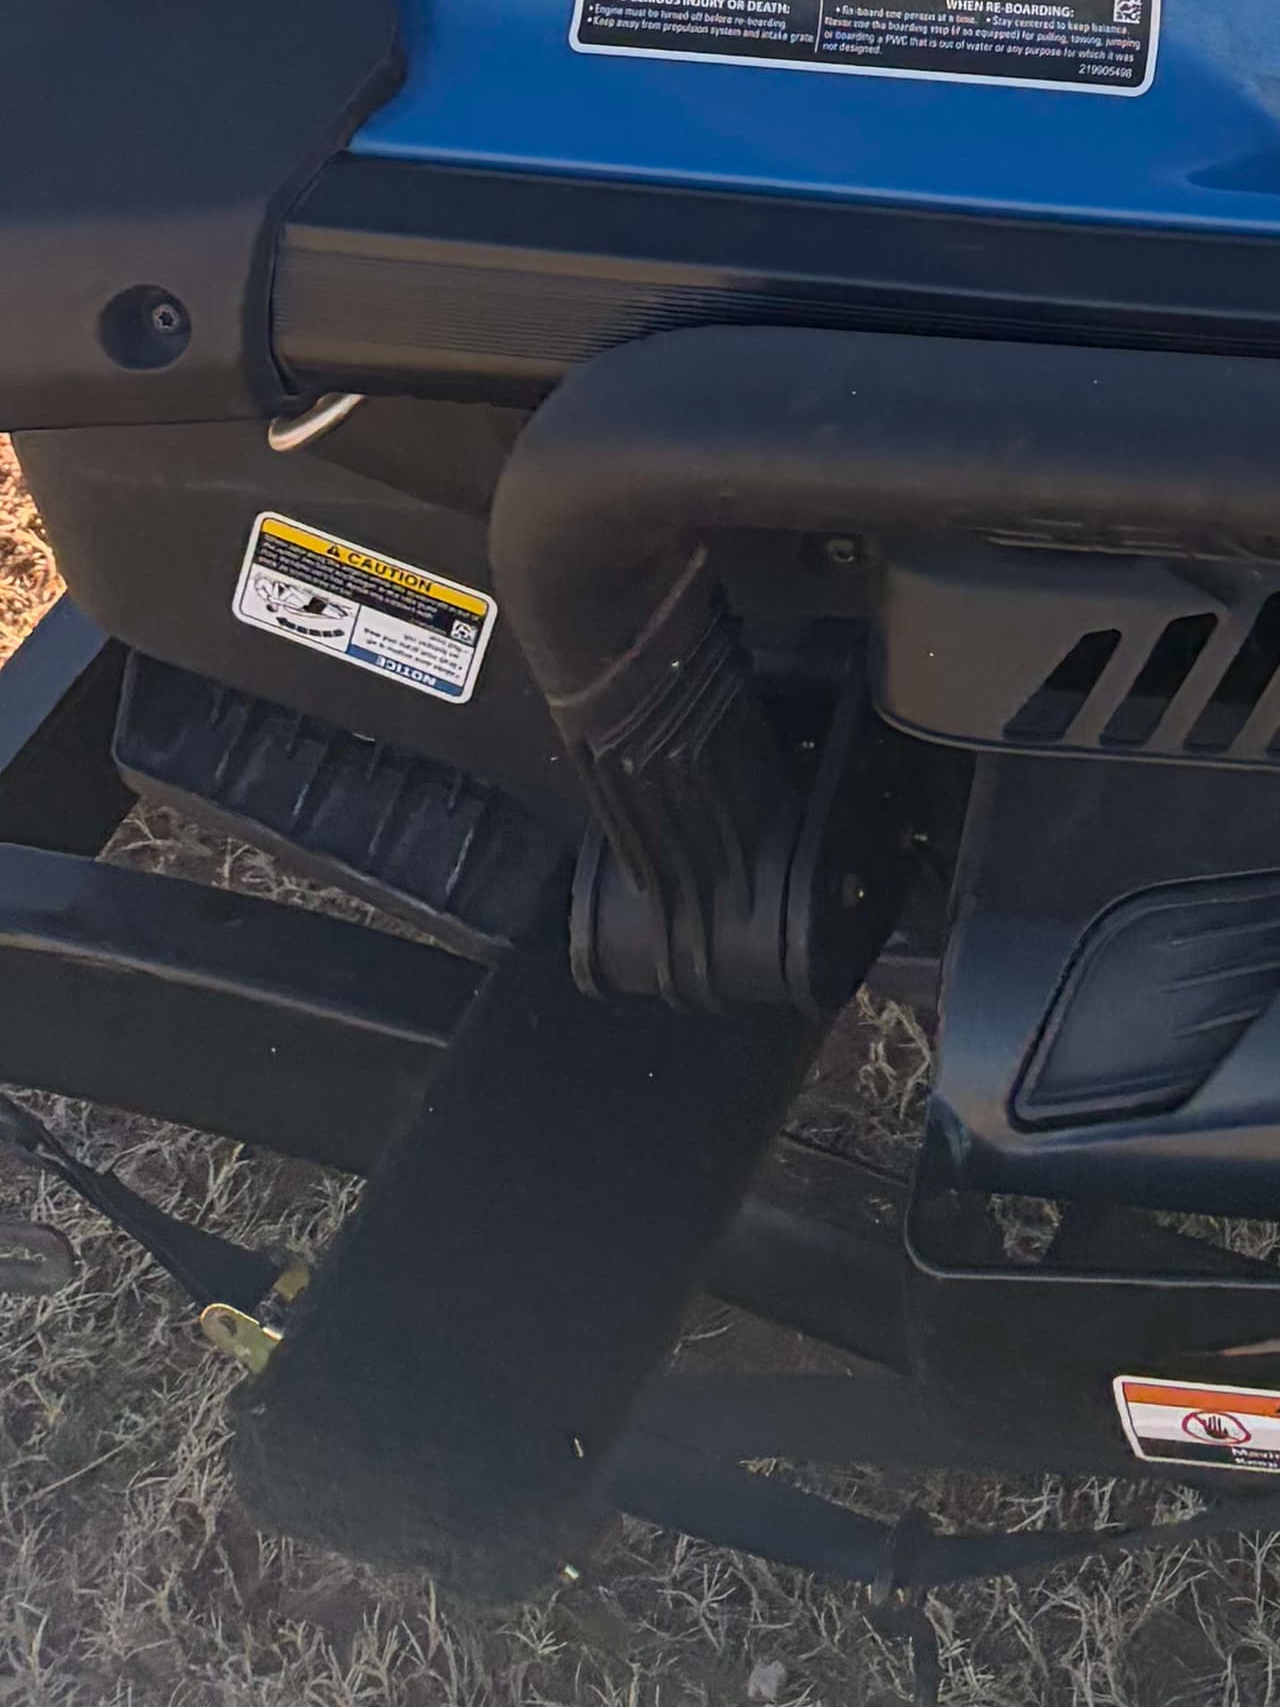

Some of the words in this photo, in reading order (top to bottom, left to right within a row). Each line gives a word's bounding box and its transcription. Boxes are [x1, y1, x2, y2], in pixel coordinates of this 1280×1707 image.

[594, 3, 623, 17] Engine
[625, 6, 646, 18] must
[647, 8, 659, 19] be
[660, 9, 689, 21] turned
[691, 11, 702, 22] off
[703, 12, 732, 25] before
[746, 0, 791, 14] DEATH:
[985, 1, 1075, 18] RE-BOARDING:
[593, 14, 614, 28] Keep
[616, 16, 639, 30] away
[640, 18, 661, 32] from
[662, 20, 708, 36] propulsion
[710, 24, 741, 38] system
[742, 27, 759, 39] and
[871, 20, 886, 31] the
[887, 21, 928, 35] boarding
[1021, 30, 1034, 43] for
[992, 16, 1012, 28] Stay
[1014, 17, 1055, 30] centered
[1056, 20, 1065, 31] to
[1067, 21, 1089, 32] keep
[822, 41, 837, 52] not
[838, 42, 882, 56] designed.
[823, 29, 833, 40] or
[834, 30, 874, 44] boarding
[884, 34, 907, 46] PWC
[909, 36, 927, 47] that
[928, 37, 936, 47] is
[939, 38, 953, 49] out
[955, 39, 965, 50] of
[966, 40, 993, 53] water
[994, 42, 1005, 54] or
[1006, 43, 1023, 56] any
[1024, 44, 1061, 58] purpose
[1064, 48, 1076, 59] for
[1078, 49, 1105, 61] which
[1114, 51, 1135, 62] was
[346, 551, 433, 593] CAUTION
[375, 655, 438, 686] NOTICE
